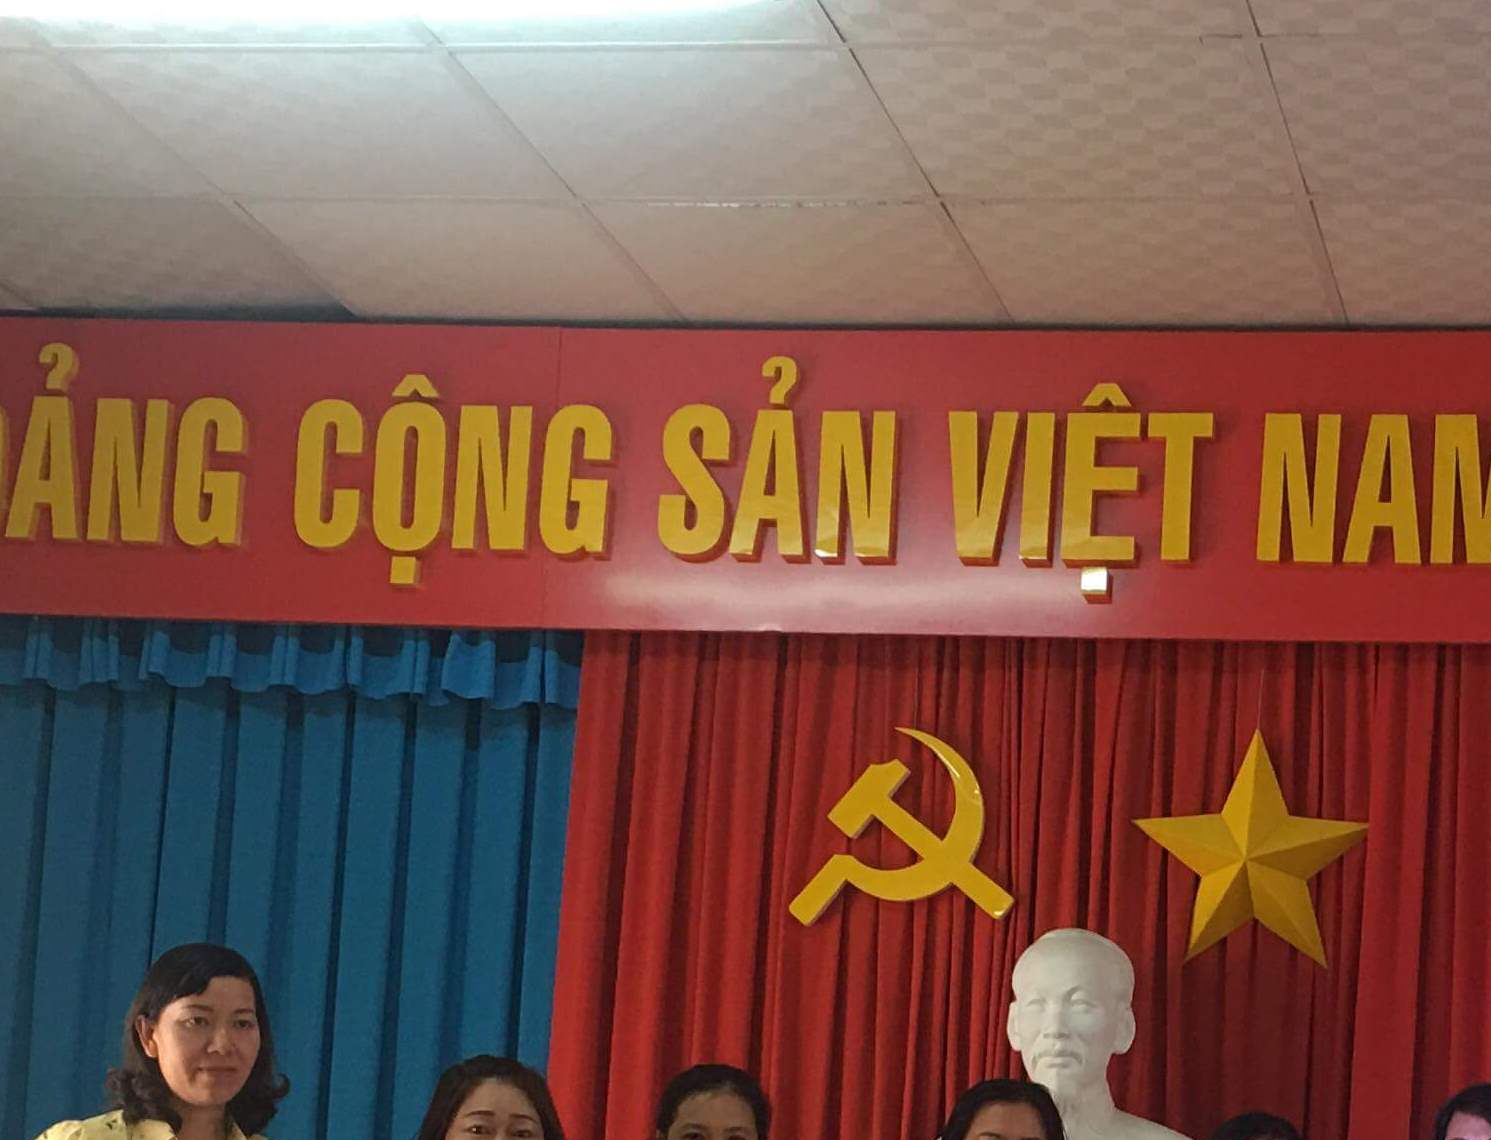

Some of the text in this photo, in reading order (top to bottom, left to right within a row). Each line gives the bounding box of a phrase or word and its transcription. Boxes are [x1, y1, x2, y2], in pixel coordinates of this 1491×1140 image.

[0, 341, 249, 546] ẢNG
[295, 375, 612, 584] CỘNG
[658, 356, 897, 564] SẢN
[948, 383, 1214, 602] VIỆT
